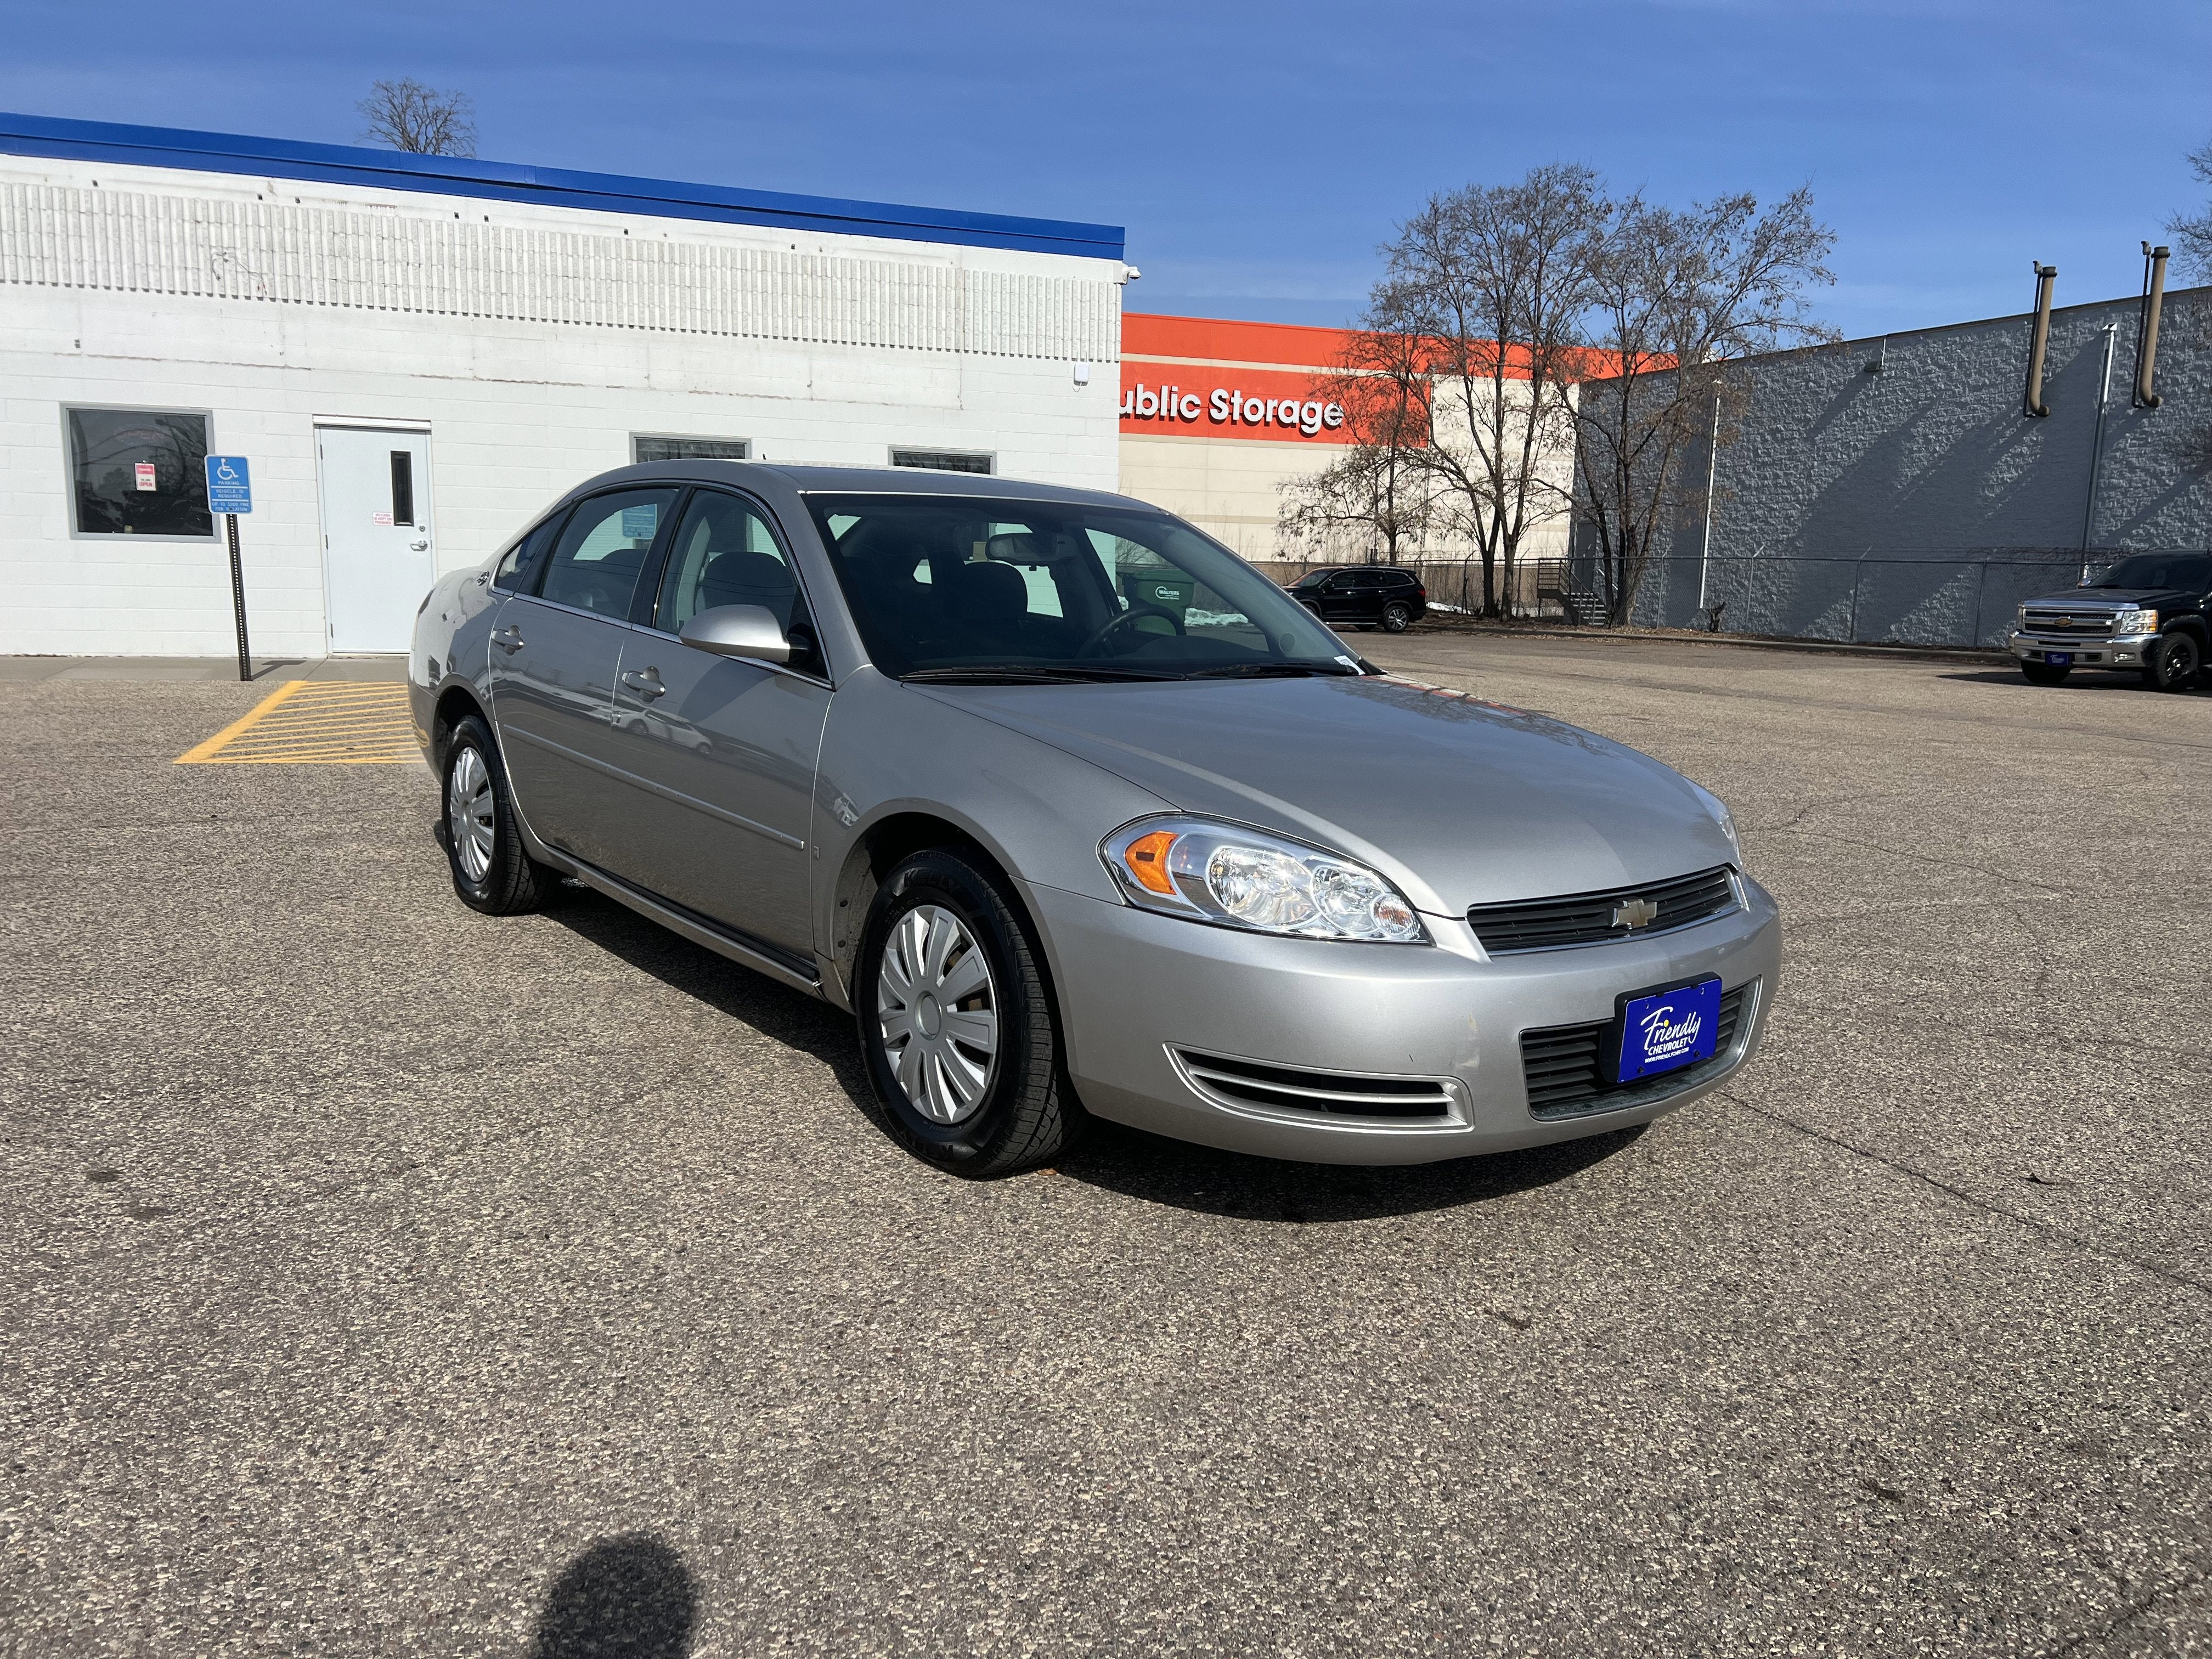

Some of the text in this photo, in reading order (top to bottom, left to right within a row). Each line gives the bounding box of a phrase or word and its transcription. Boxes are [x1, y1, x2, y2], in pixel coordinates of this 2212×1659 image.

[1119, 383, 1344, 433] ublic Storage
[1640, 1006, 1701, 1050] Friendly
[1648, 1036, 1688, 1056] CHEVROLET
